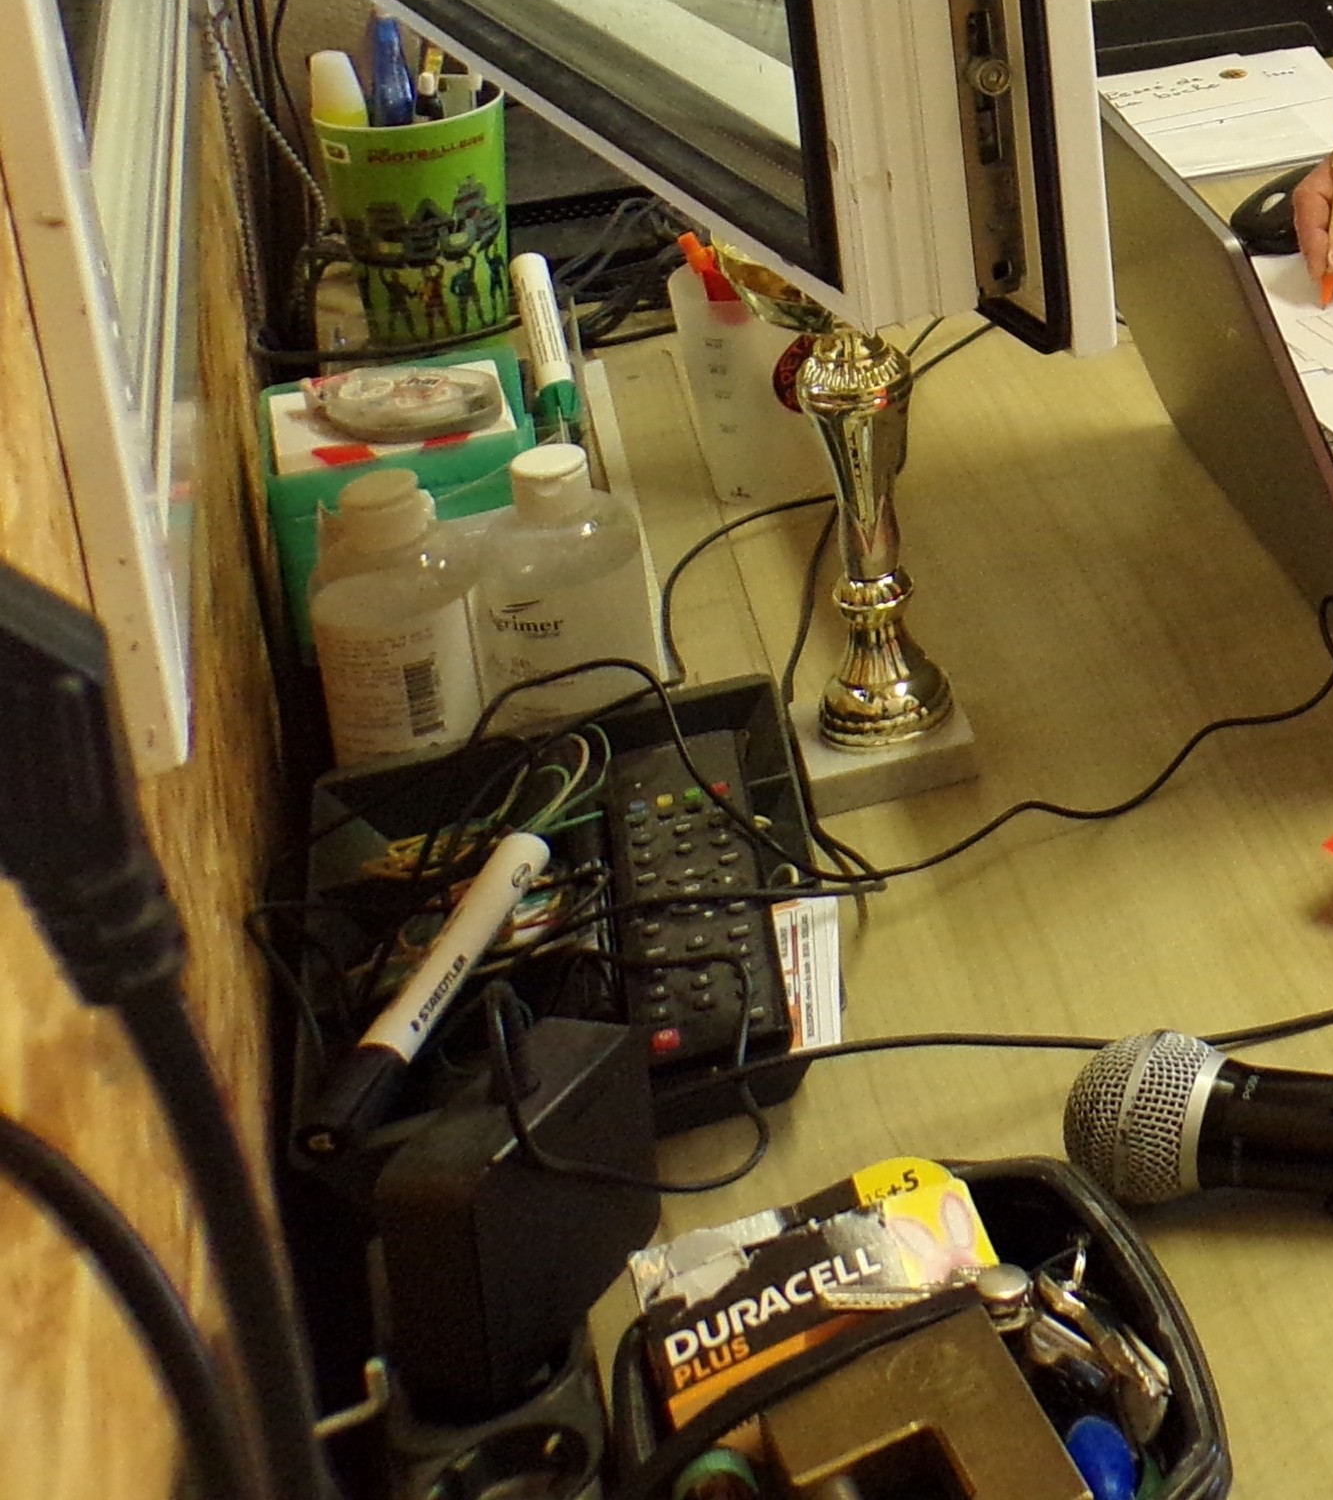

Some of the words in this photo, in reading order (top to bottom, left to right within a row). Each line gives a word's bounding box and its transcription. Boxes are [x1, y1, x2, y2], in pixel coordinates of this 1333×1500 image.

[419, 953, 469, 1022] STAEDTLER
[664, 1247, 883, 1367] DURACELL
[672, 1337, 750, 1390] PLUS
